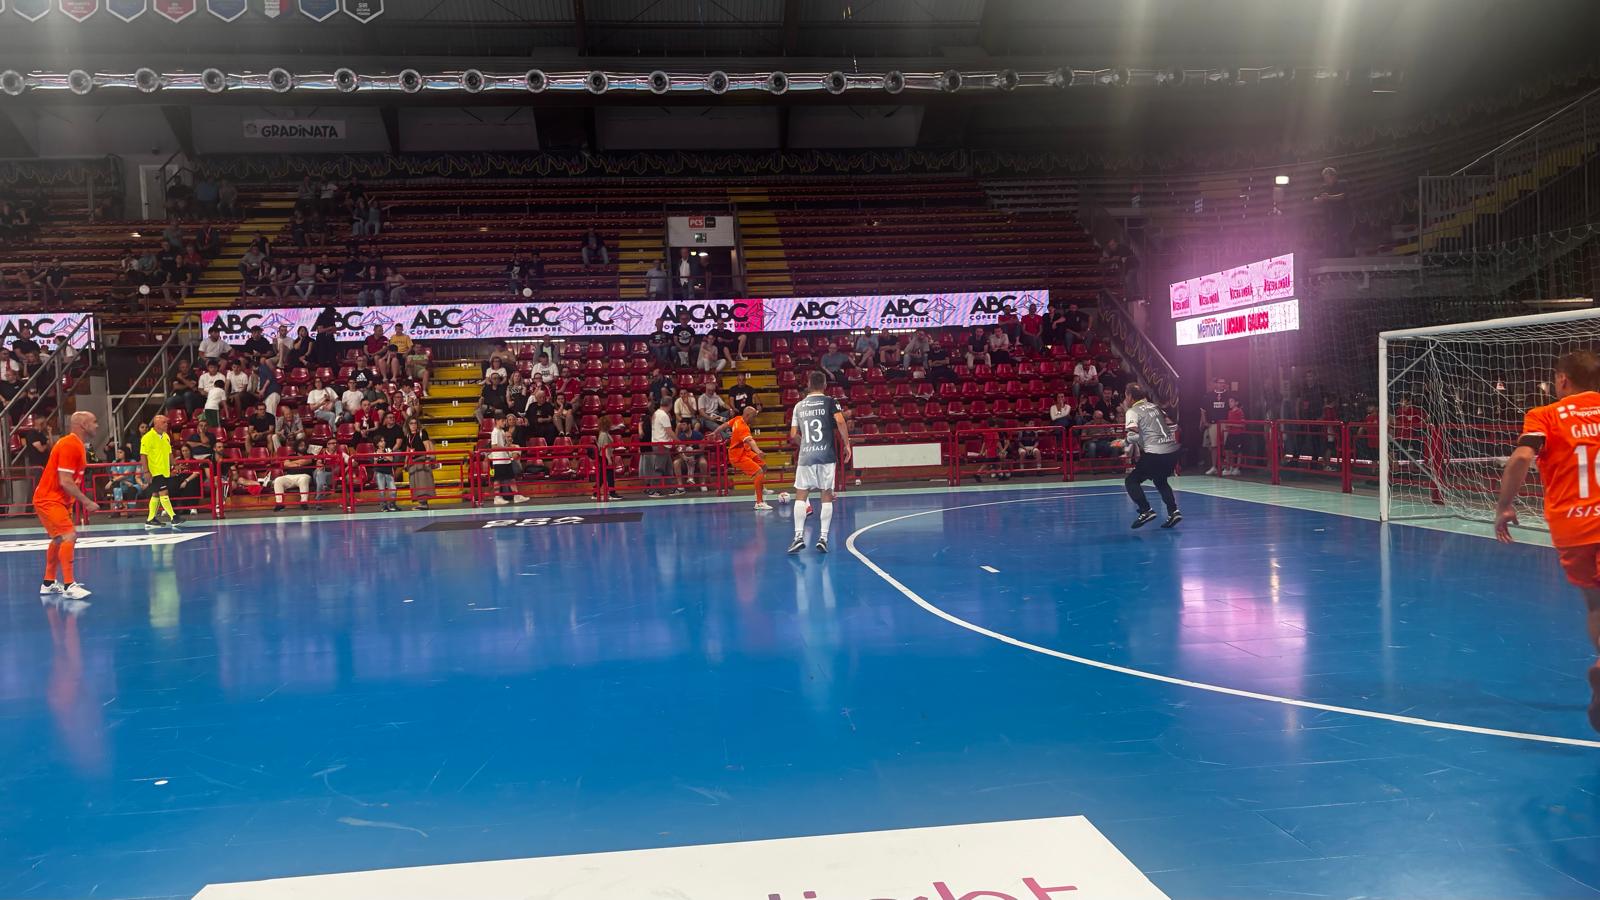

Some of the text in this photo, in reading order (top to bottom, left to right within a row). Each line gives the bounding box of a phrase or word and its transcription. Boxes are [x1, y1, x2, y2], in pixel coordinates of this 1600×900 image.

[509, 306, 561, 326] ABC
[791, 301, 839, 320] ABC
[880, 299, 929, 317] ABC
[209, 313, 263, 334] ABC
[411, 309, 463, 329] ABC
[1197, 320, 1223, 338] Memorial
[1223, 315, 1247, 336] LUCIANO
[410, 328, 464, 336] COPERTURE
[803, 418, 823, 444] 13
